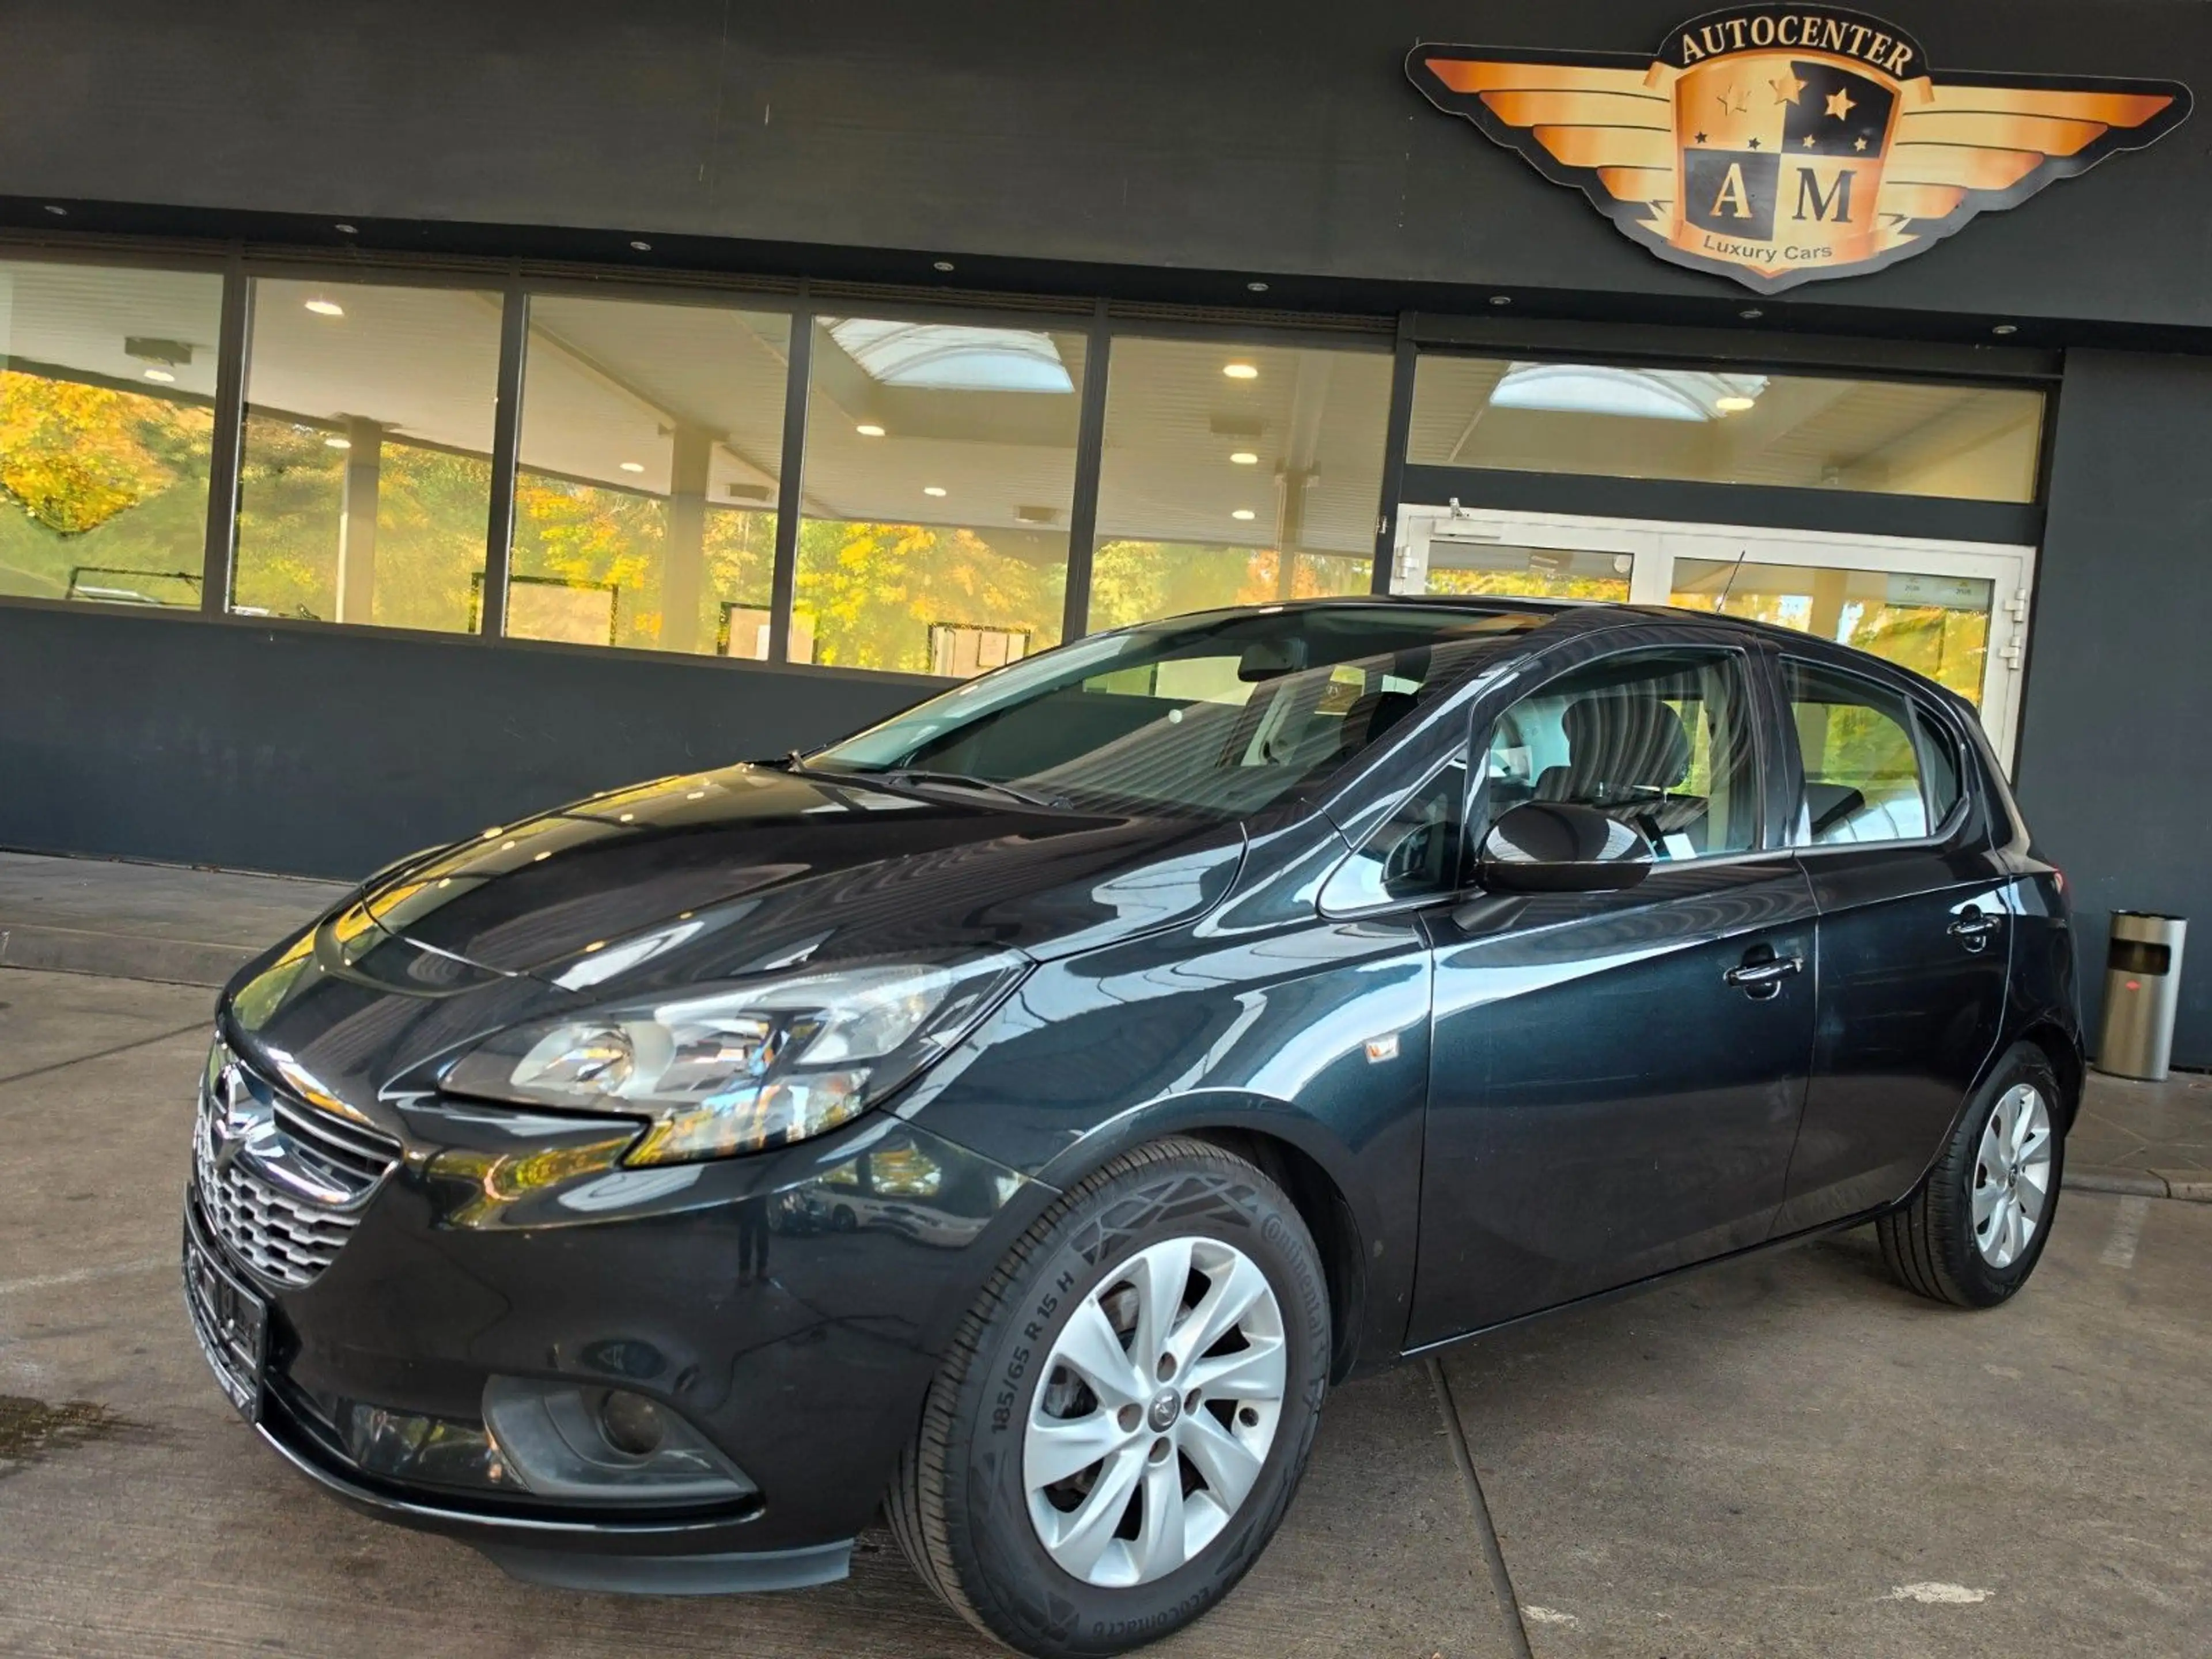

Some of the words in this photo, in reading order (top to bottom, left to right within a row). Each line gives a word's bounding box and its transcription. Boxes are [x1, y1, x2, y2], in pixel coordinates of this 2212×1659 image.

[1682, 16, 1912, 76] AUTOCENTER
[1709, 162, 1752, 218] A
[1791, 167, 1857, 222] M
[1703, 235, 1777, 262] Luxury
[1785, 245, 1833, 260] Cars
[991, 1346, 1030, 1434] 185/65
[1024, 1321, 1042, 1341] R
[1037, 1293, 1058, 1319] 15
[1056, 1271, 1075, 1293] H
